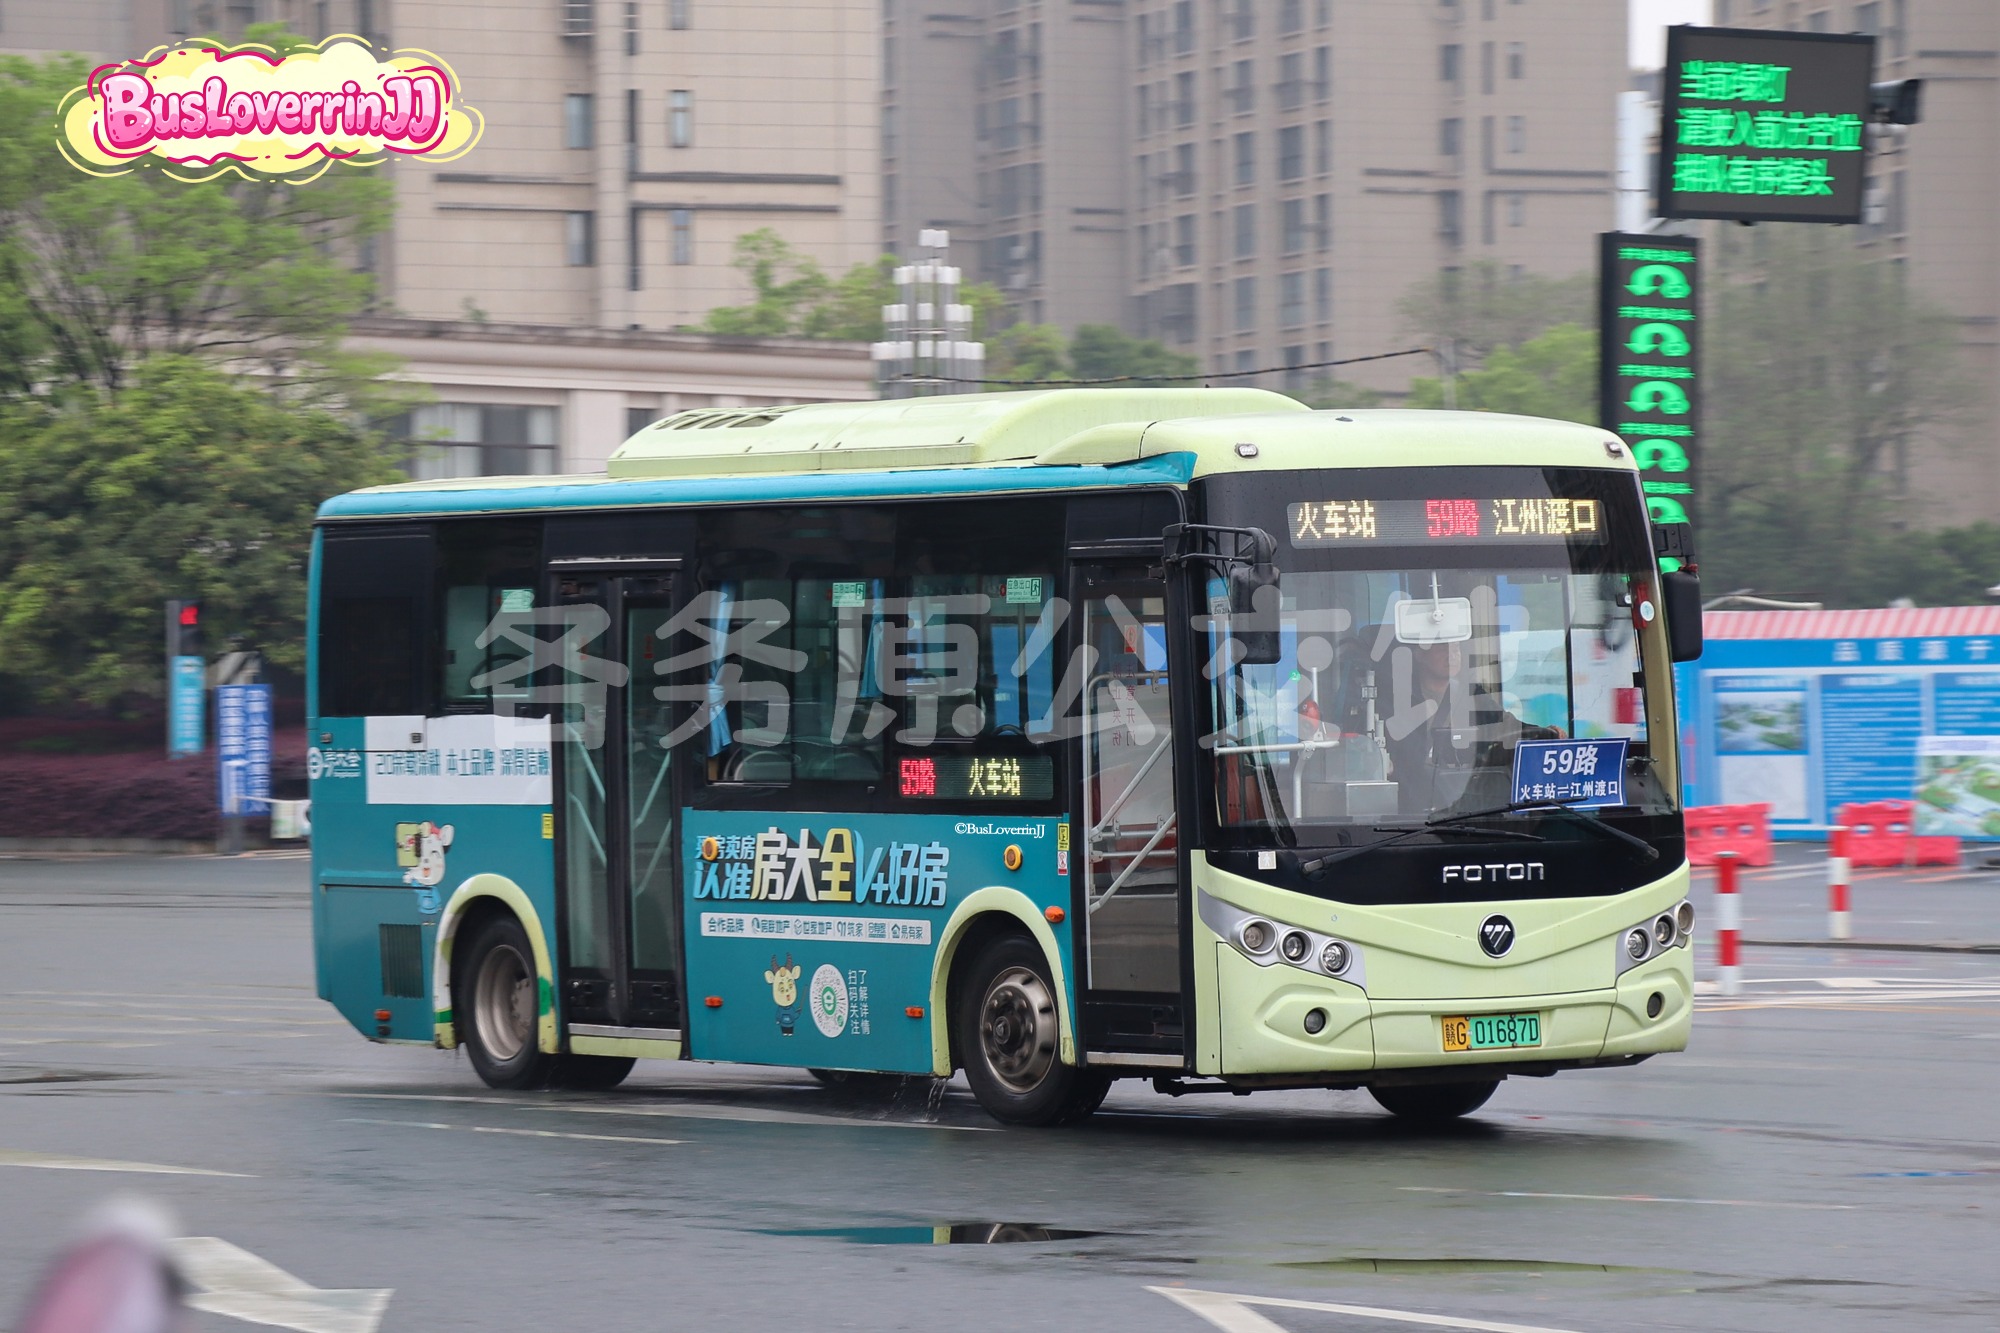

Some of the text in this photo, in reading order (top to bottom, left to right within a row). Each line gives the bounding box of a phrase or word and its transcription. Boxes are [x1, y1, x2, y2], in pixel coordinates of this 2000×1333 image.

[1296, 498, 1598, 539] 火车站 59路 江州渡口
[901, 758, 1021, 796] 59路 火车站
[1542, 745, 1598, 776] 59路
[1520, 780, 1618, 800] 火车站 江州渡口
[693, 861, 753, 899] 认准
[1442, 862, 1544, 883] FOTON
[708, 917, 745, 933] 合作品牌
[848, 969, 861, 1035] 扫码关注
[858, 969, 871, 1035] 了解详情
